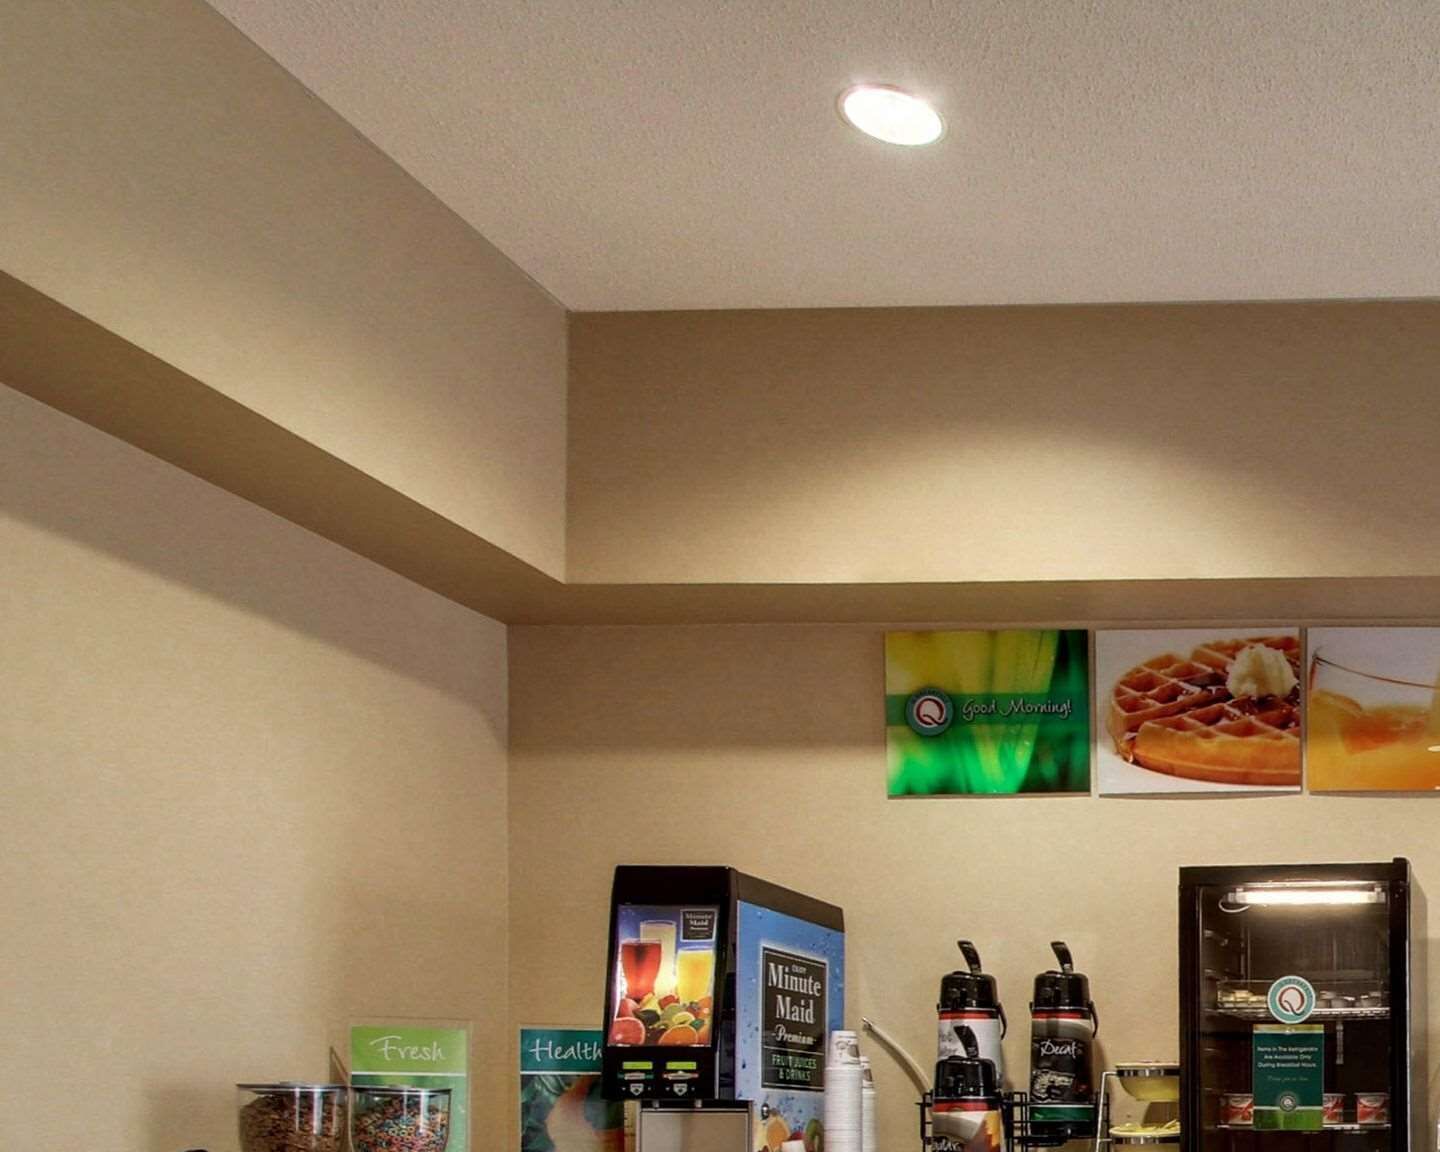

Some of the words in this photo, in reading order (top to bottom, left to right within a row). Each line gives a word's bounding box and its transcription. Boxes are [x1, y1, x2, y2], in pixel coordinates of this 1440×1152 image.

[962, 699, 996, 721] Good
[1000, 698, 1072, 719] Morning!
[767, 962, 822, 997] Minute
[775, 994, 815, 1024] Maid
[369, 1035, 447, 1062] Fresh
[529, 1038, 603, 1062] Health
[1040, 1039, 1078, 1059] Decaf
